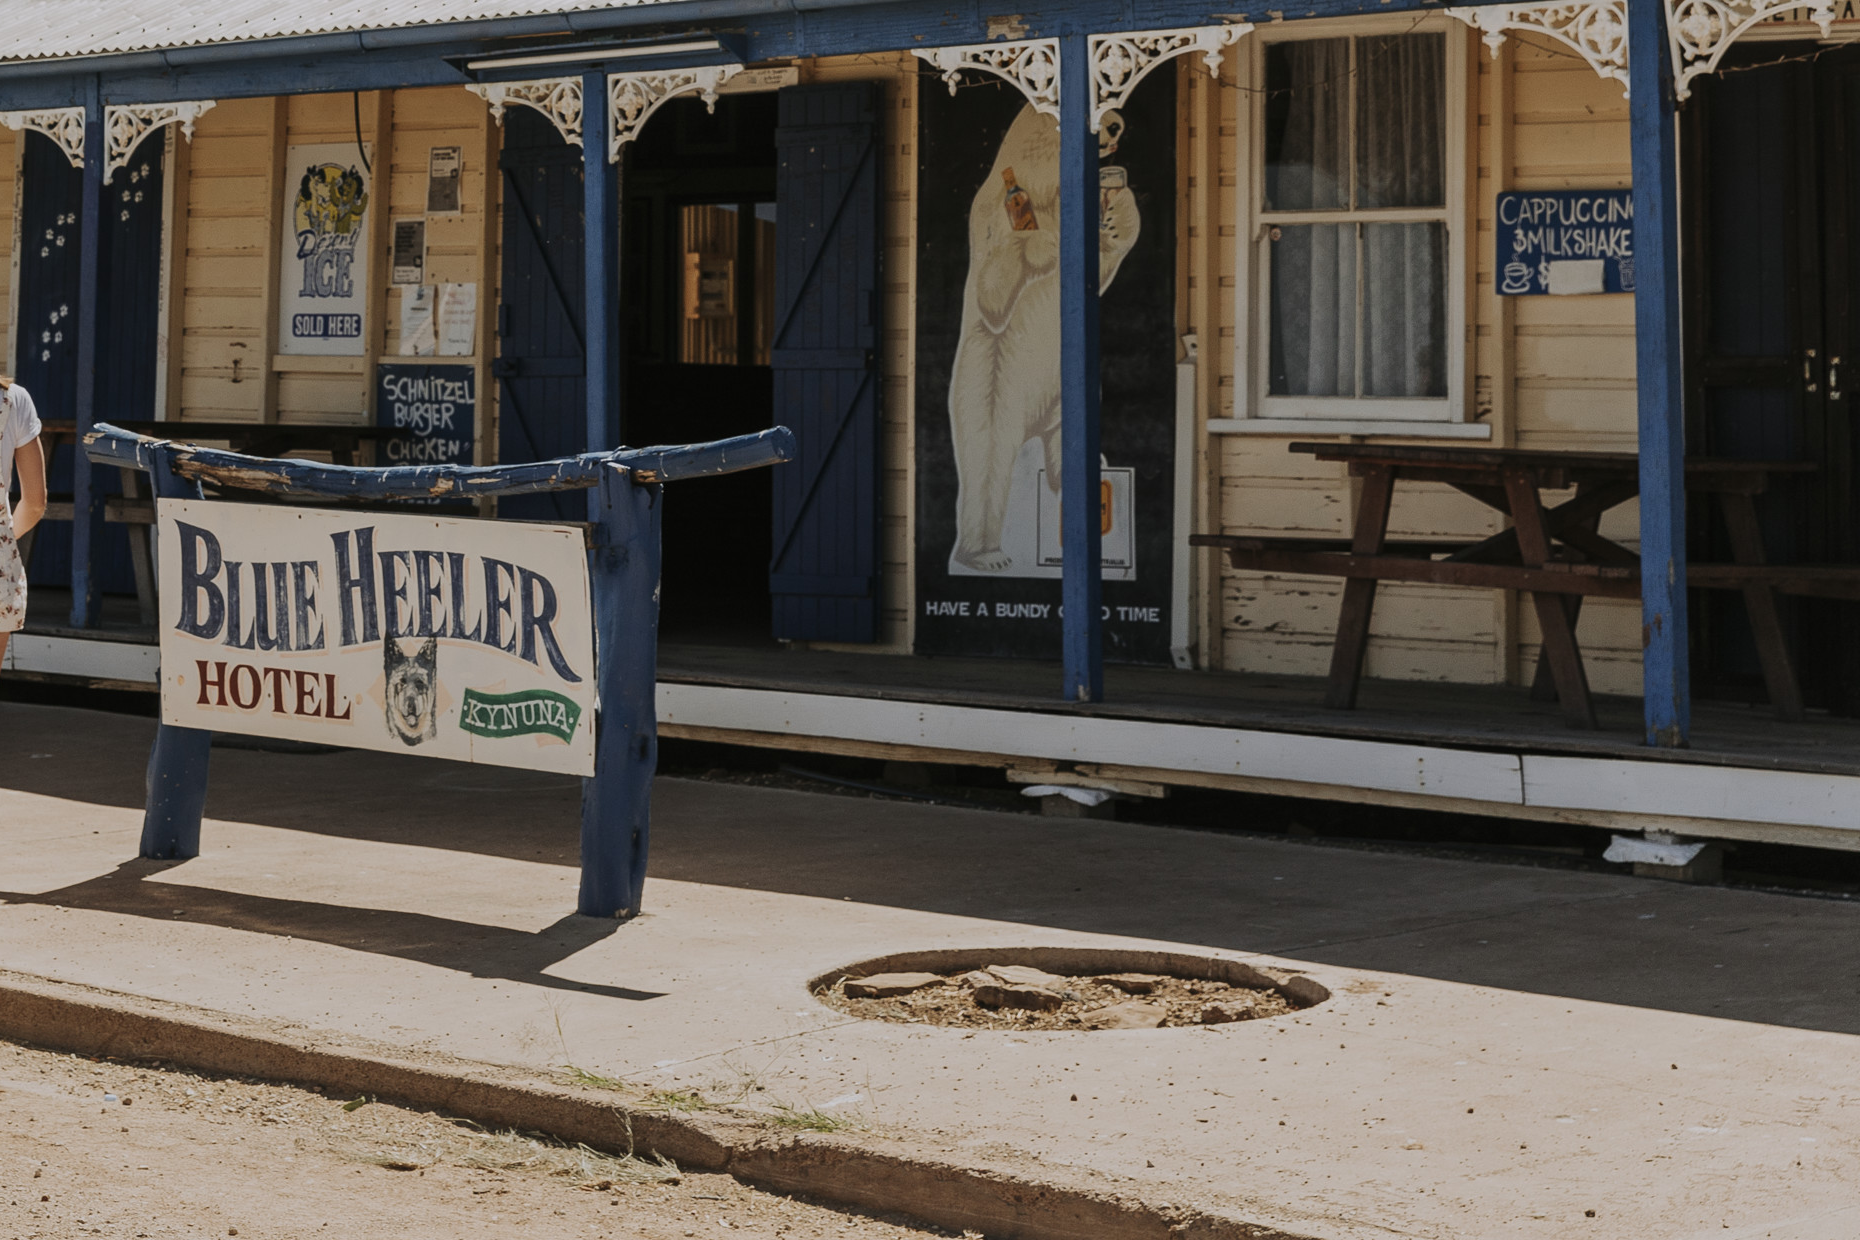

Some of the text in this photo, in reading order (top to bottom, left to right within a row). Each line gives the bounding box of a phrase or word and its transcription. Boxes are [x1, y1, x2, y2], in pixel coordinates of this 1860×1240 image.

[1499, 194, 1634, 226] CAPPUCCIN
[299, 247, 355, 298] ICE
[294, 315, 359, 335] SOLD HERE
[174, 519, 583, 684] BLUE HEELER
[926, 601, 970, 617] HAVE
[977, 601, 989, 617] A
[995, 603, 1051, 618] BUNDY
[1116, 606, 1160, 623] TIME
[195, 660, 351, 720] HOTEL
[465, 697, 569, 733] KYNUNA
